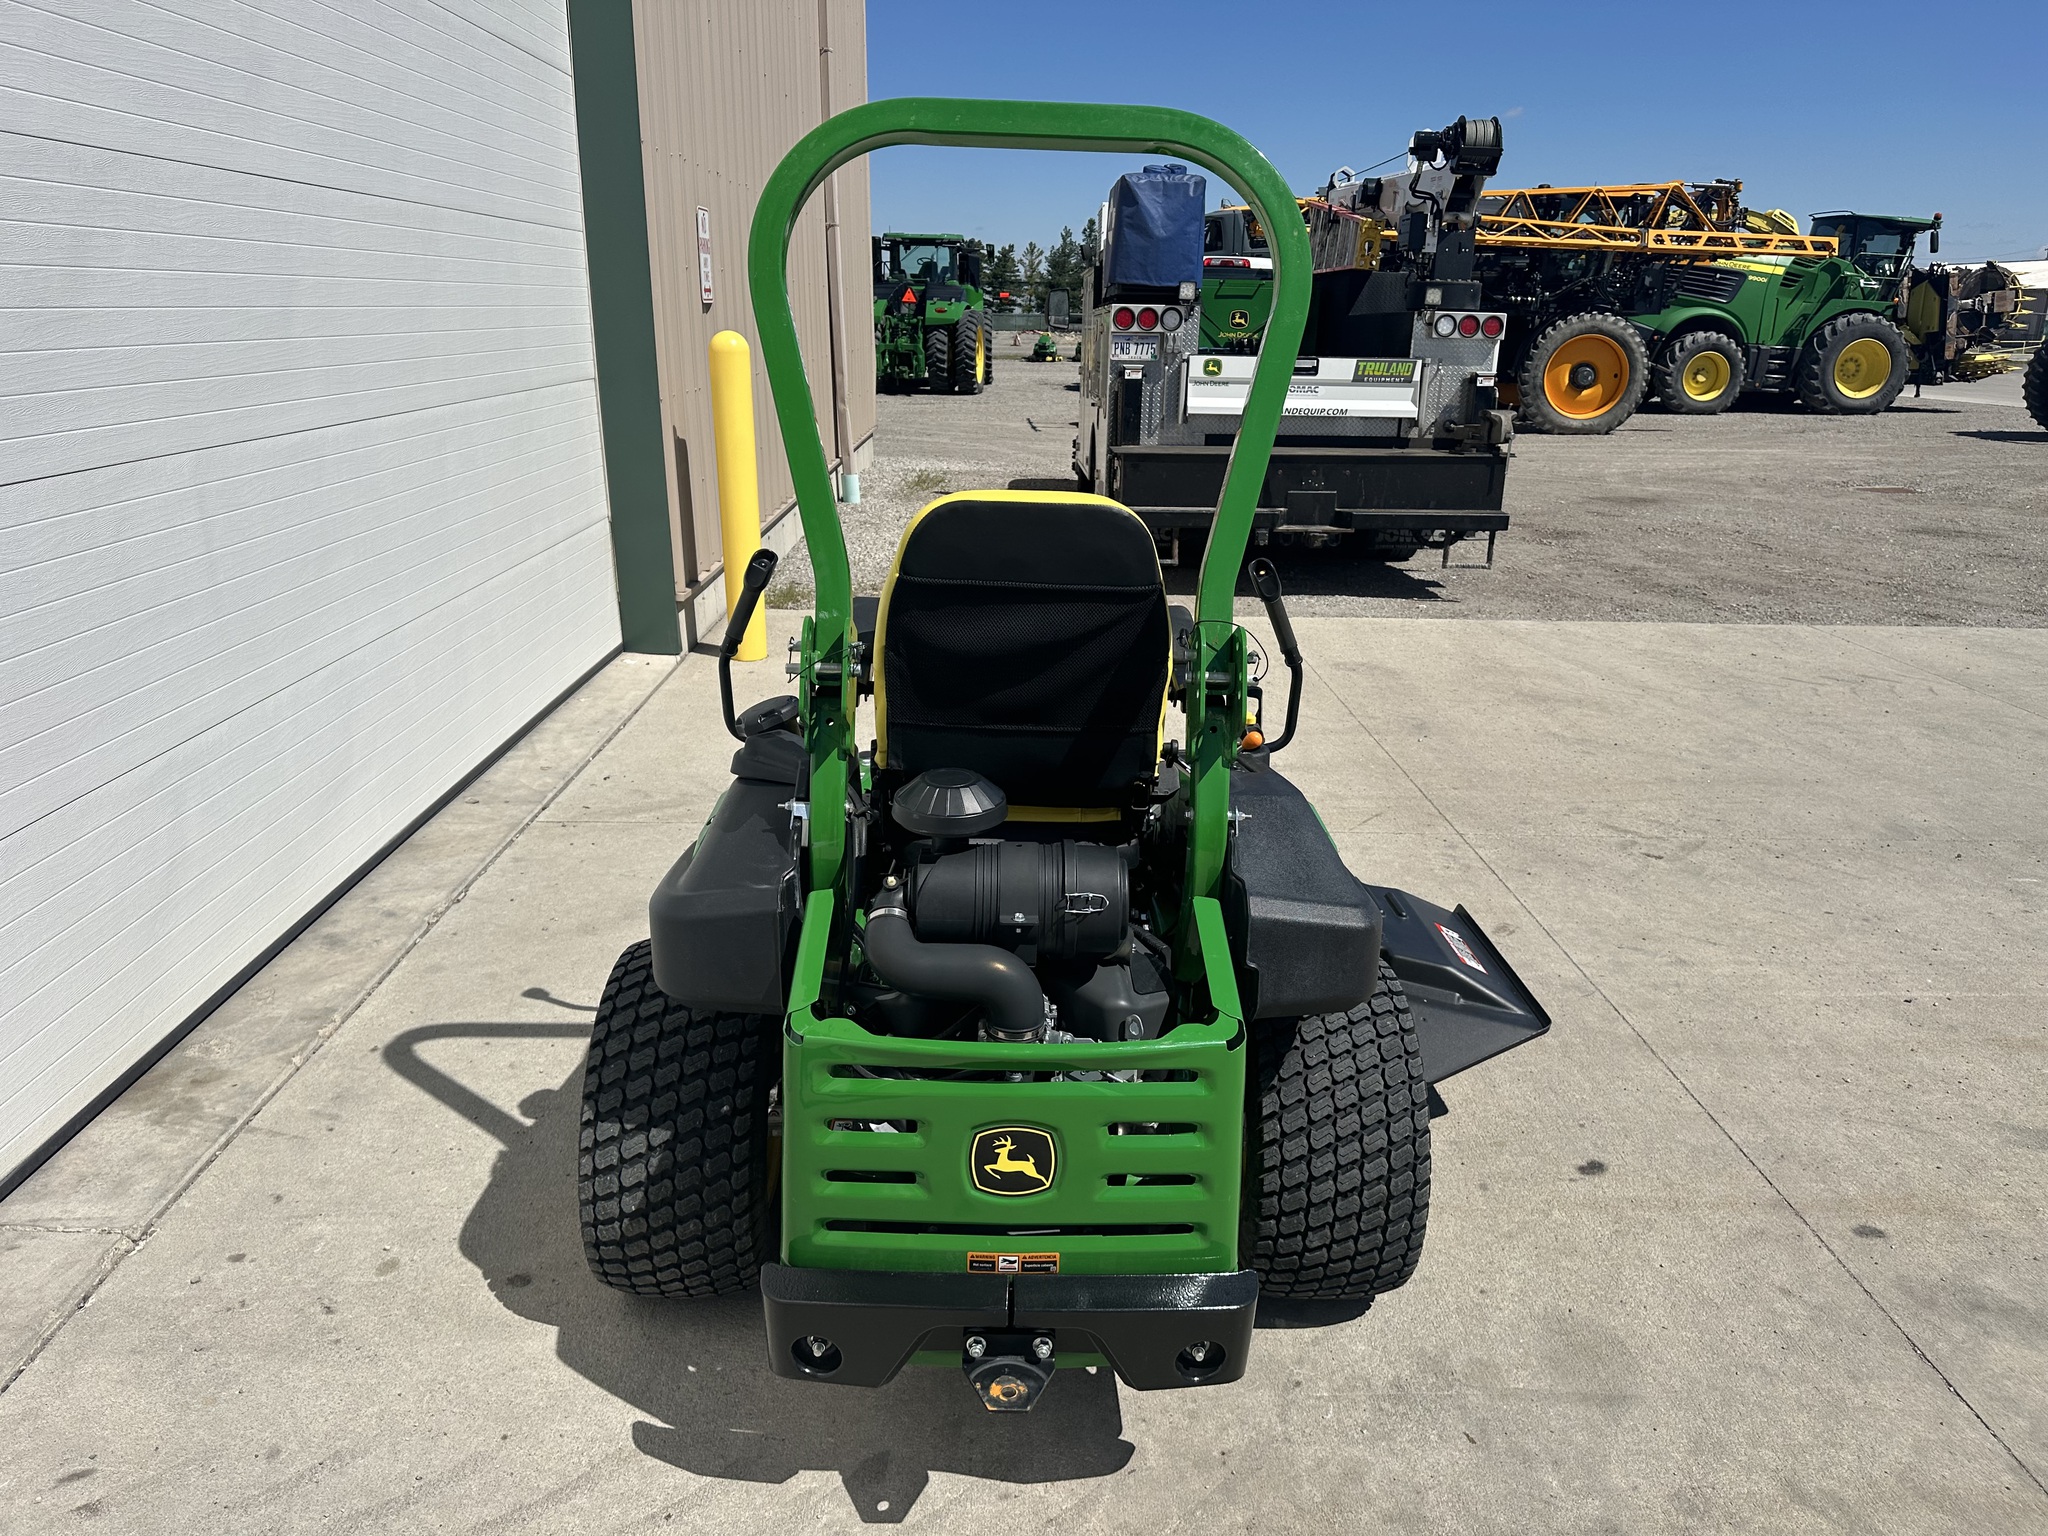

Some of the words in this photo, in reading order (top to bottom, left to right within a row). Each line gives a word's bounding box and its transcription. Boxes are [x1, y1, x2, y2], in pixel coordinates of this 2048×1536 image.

[1114, 341, 1131, 355] PNB
[1134, 342, 1156, 356] 7775
[1357, 361, 1414, 376] TRULAND
